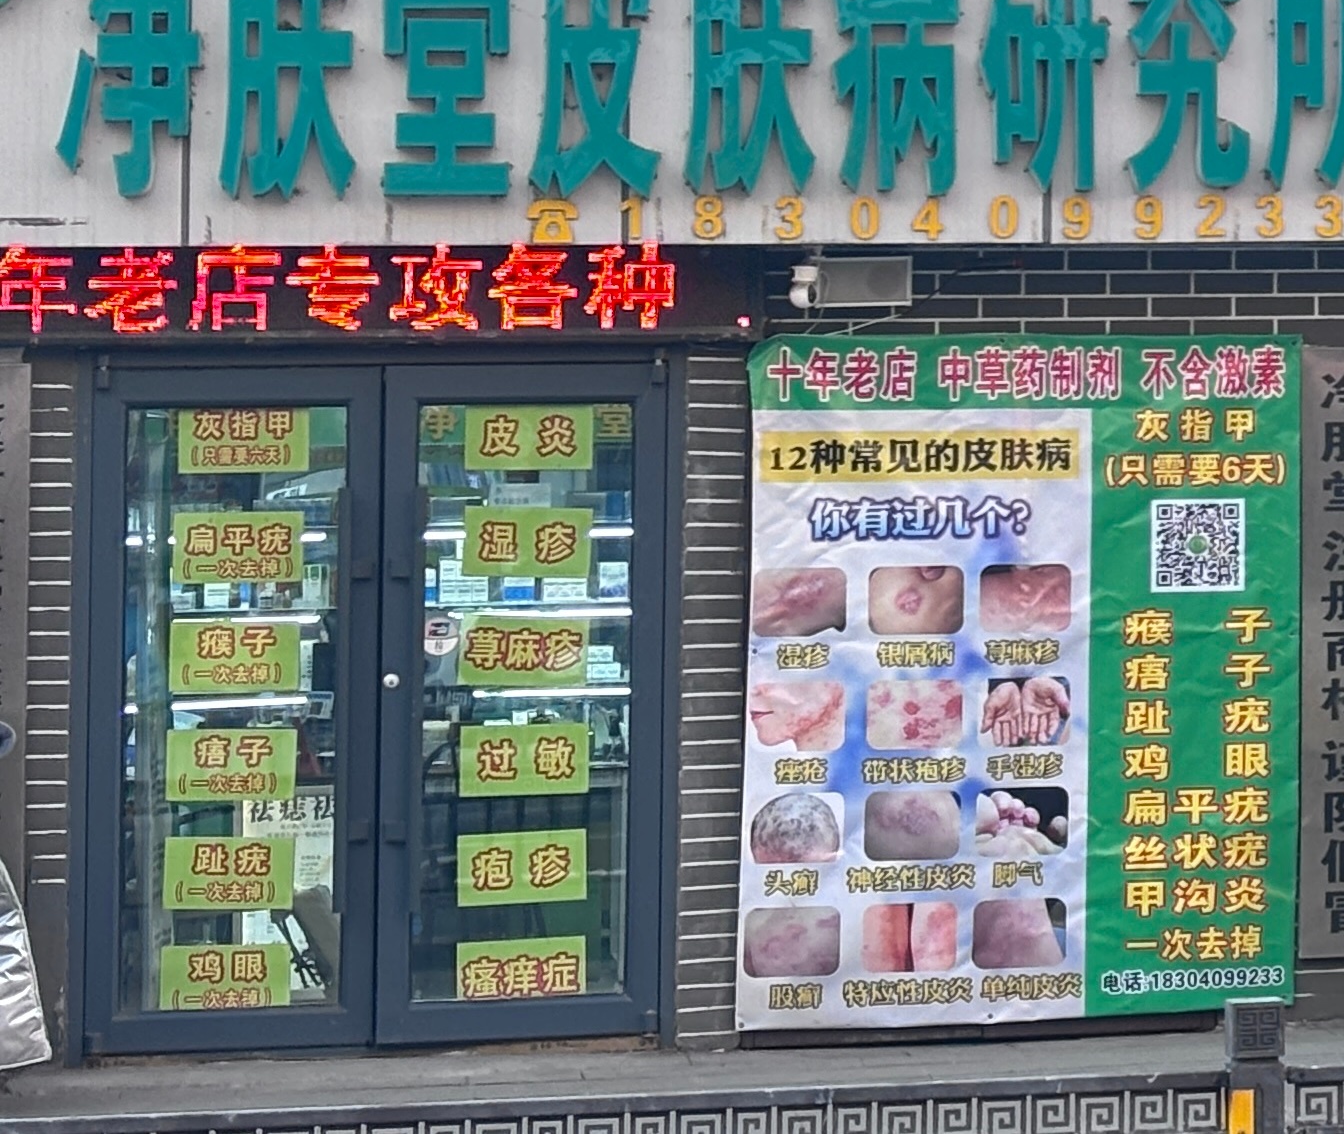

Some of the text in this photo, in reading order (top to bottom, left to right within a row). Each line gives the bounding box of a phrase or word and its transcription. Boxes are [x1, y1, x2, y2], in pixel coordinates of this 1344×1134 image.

[0, 241, 677, 333] 年老店专攻各种
[766, 344, 1286, 402] 十年老店 中草药制剂 不含激素
[193, 410, 294, 441] 灰指甲
[479, 414, 579, 458] 皮炎
[1136, 408, 1256, 443] 灰指甲
[768, 437, 1073, 476] 12种常见的皮肤病
[185, 523, 293, 556] 扁平疣
[478, 519, 578, 565] 湿疹
[464, 625, 584, 672] 荨麻疹
[777, 639, 1060, 670] 湿疹 银屑病 荨麻疹
[1122, 653, 1272, 692] 痦子
[1122, 696, 1271, 736] 趾疣
[477, 736, 576, 782] 过敏
[863, 756, 968, 784] 带状疱疹
[988, 754, 1064, 780] 手湿疹
[1122, 742, 1271, 782] 鸡眼
[1122, 786, 1270, 826] 扁平疣
[192, 842, 272, 877] 趾疣
[471, 842, 572, 891] 疱疹
[1122, 831, 1269, 871] 丝状疣
[764, 861, 1044, 896] 头癣 神经性皮炎 脚气
[1123, 877, 1268, 919] 甲沟炎
[1125, 923, 1264, 962] 一次去掉
[188, 950, 268, 983] 鸡眼
[461, 951, 581, 1002] 瘙痒症
[842, 977, 974, 1006] 特应性皮炎
[981, 973, 1084, 1003] 单纯皮炎
